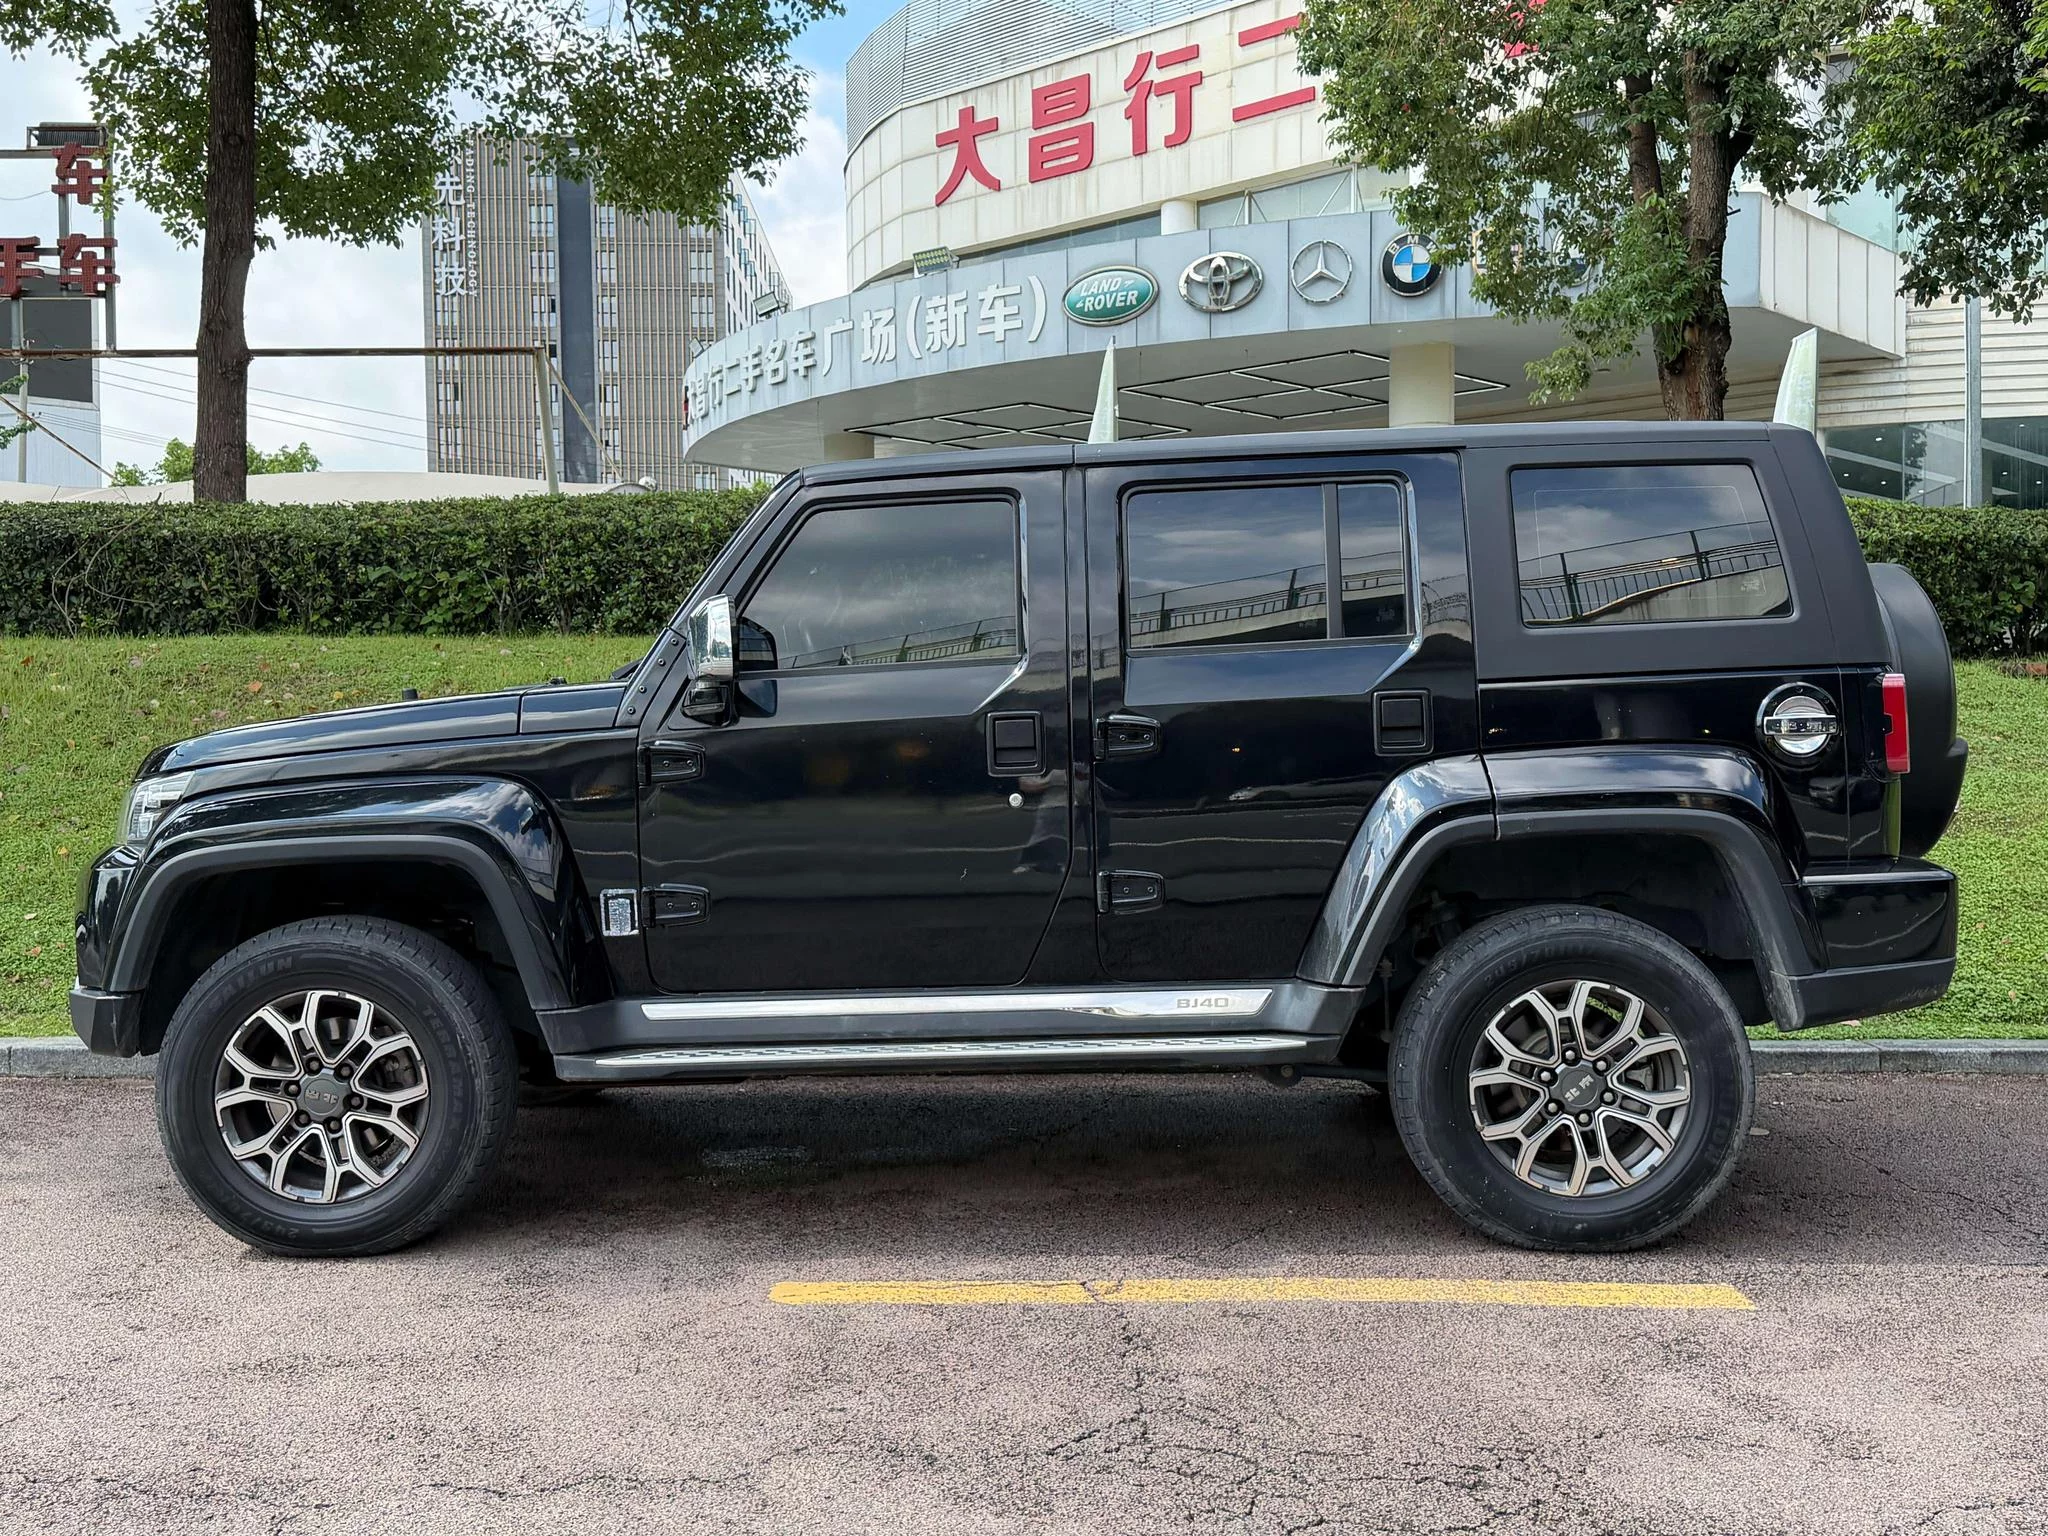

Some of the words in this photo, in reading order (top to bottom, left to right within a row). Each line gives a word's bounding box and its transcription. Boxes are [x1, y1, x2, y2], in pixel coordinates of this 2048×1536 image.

[51, 142, 108, 206] 车
[431, 131, 468, 297] 先科技
[466, 201, 479, 297] TECHNOLOGY
[1388, 235, 1438, 255] BMW
[1080, 277, 1122, 297] LAND
[1083, 290, 1139, 312] ROVER
[1176, 997, 1230, 1009] BJ40
